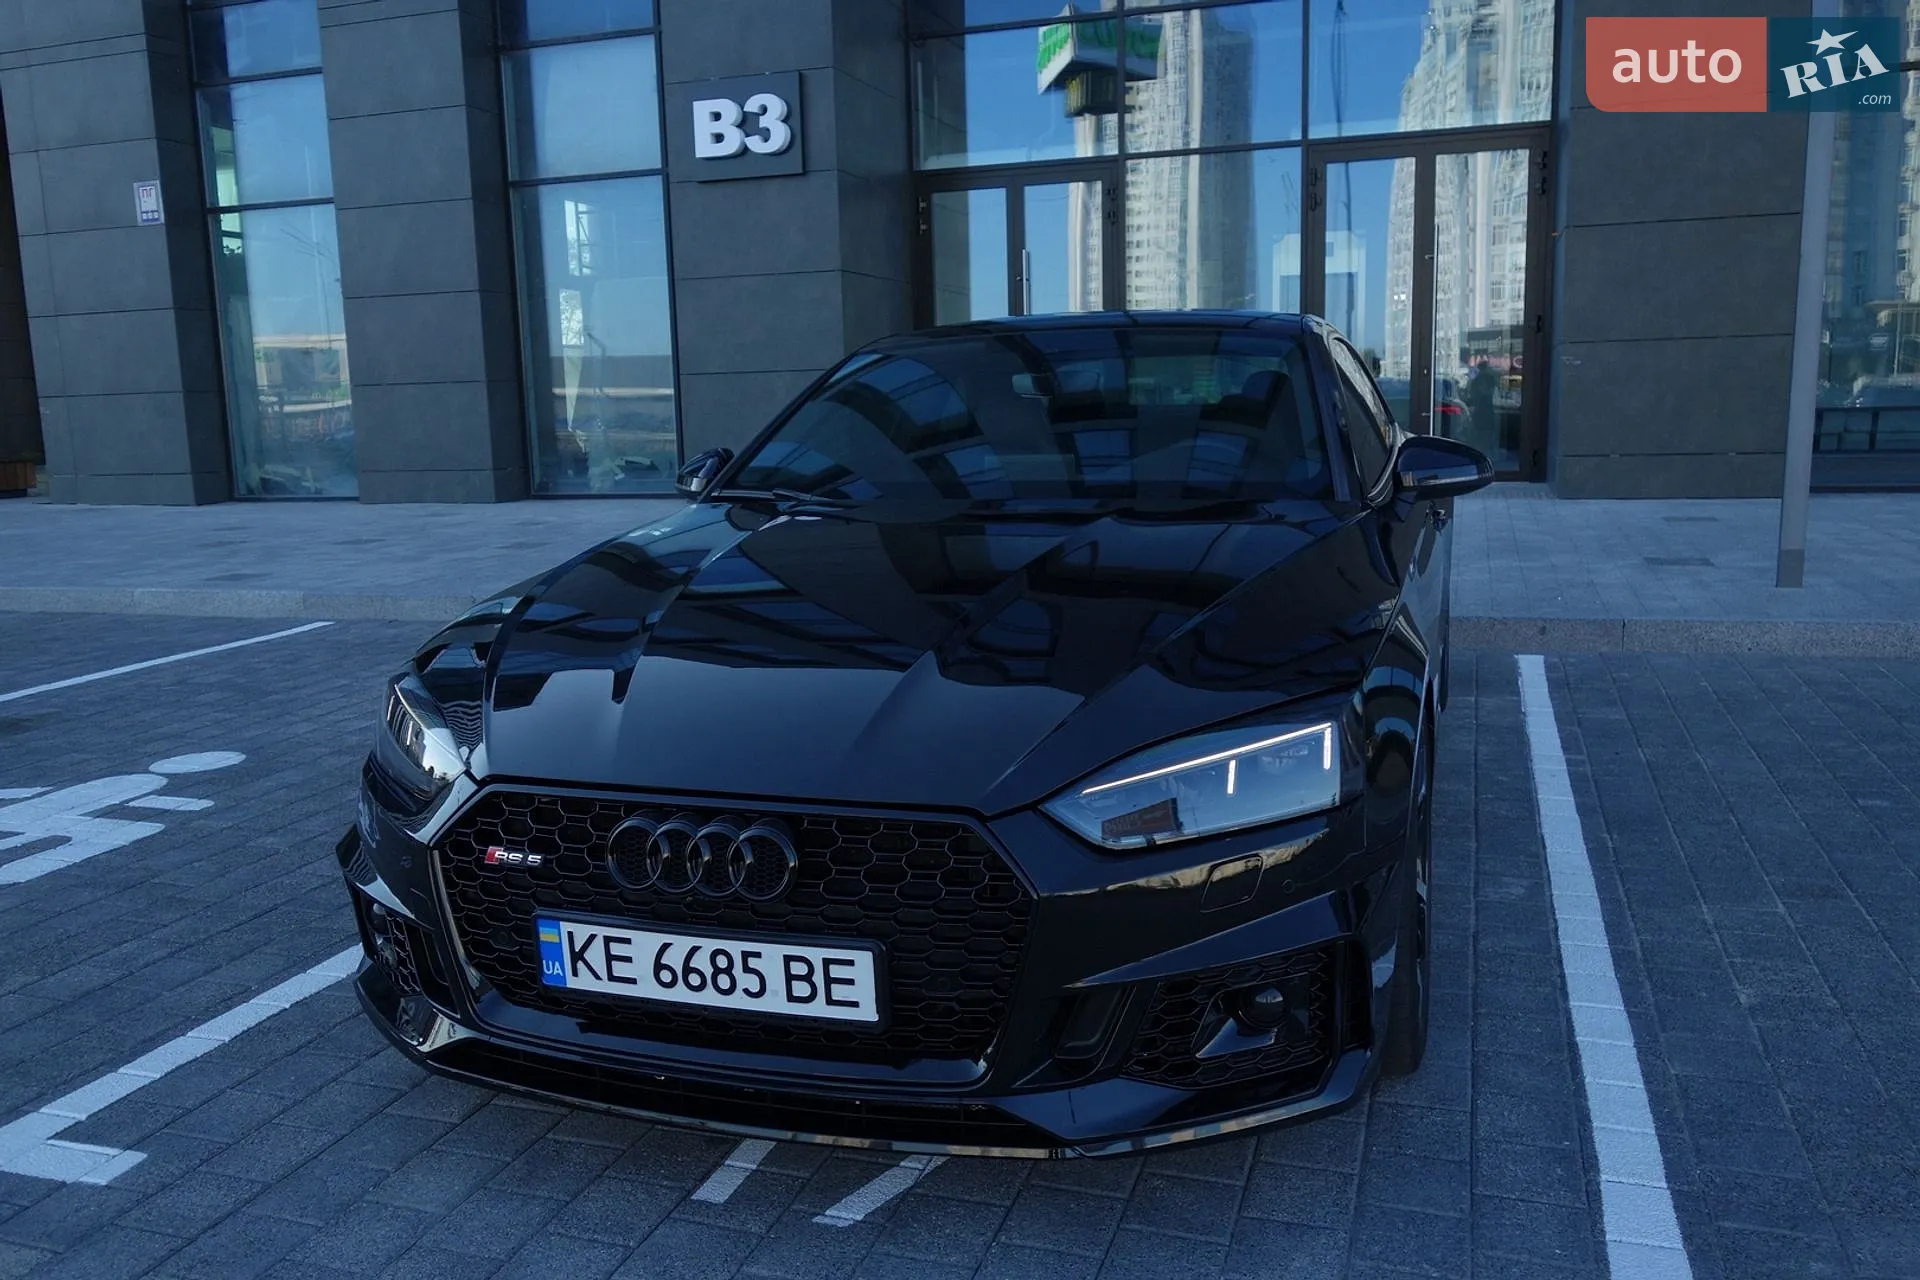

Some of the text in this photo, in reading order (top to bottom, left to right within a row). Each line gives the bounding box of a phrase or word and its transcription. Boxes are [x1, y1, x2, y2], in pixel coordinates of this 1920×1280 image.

[693, 93, 791, 158] B3
[543, 960, 564, 977] UA
[567, 931, 860, 1008] KE 6685 BE
